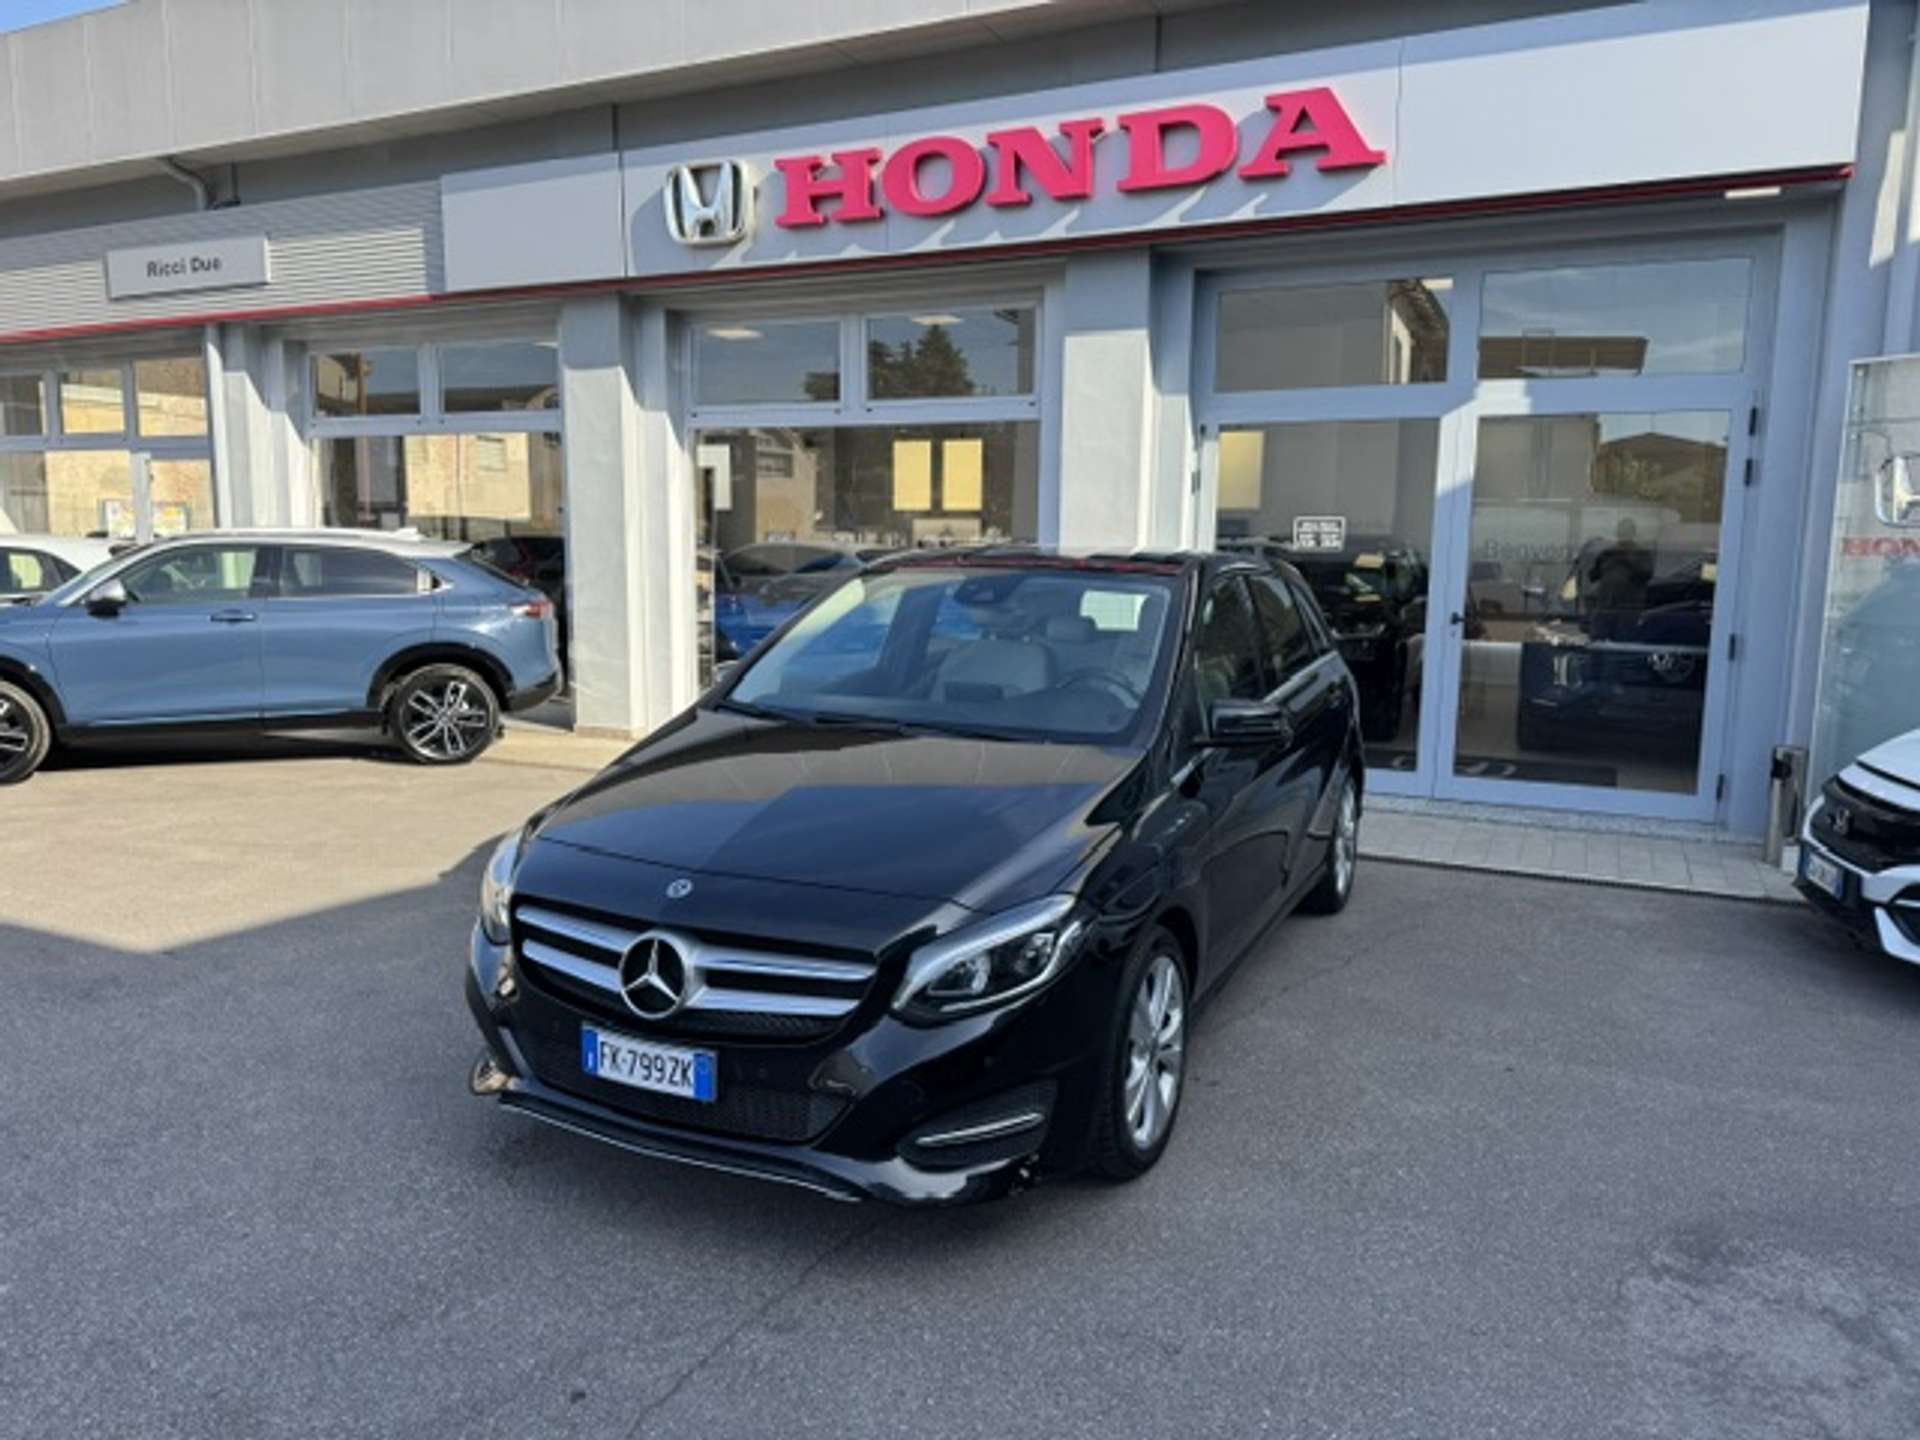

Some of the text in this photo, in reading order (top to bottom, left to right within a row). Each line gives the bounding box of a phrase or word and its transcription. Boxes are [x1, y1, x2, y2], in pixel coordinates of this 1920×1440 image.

[774, 86, 1386, 230] HONDA
[146, 256, 222, 277] Ricci Due
